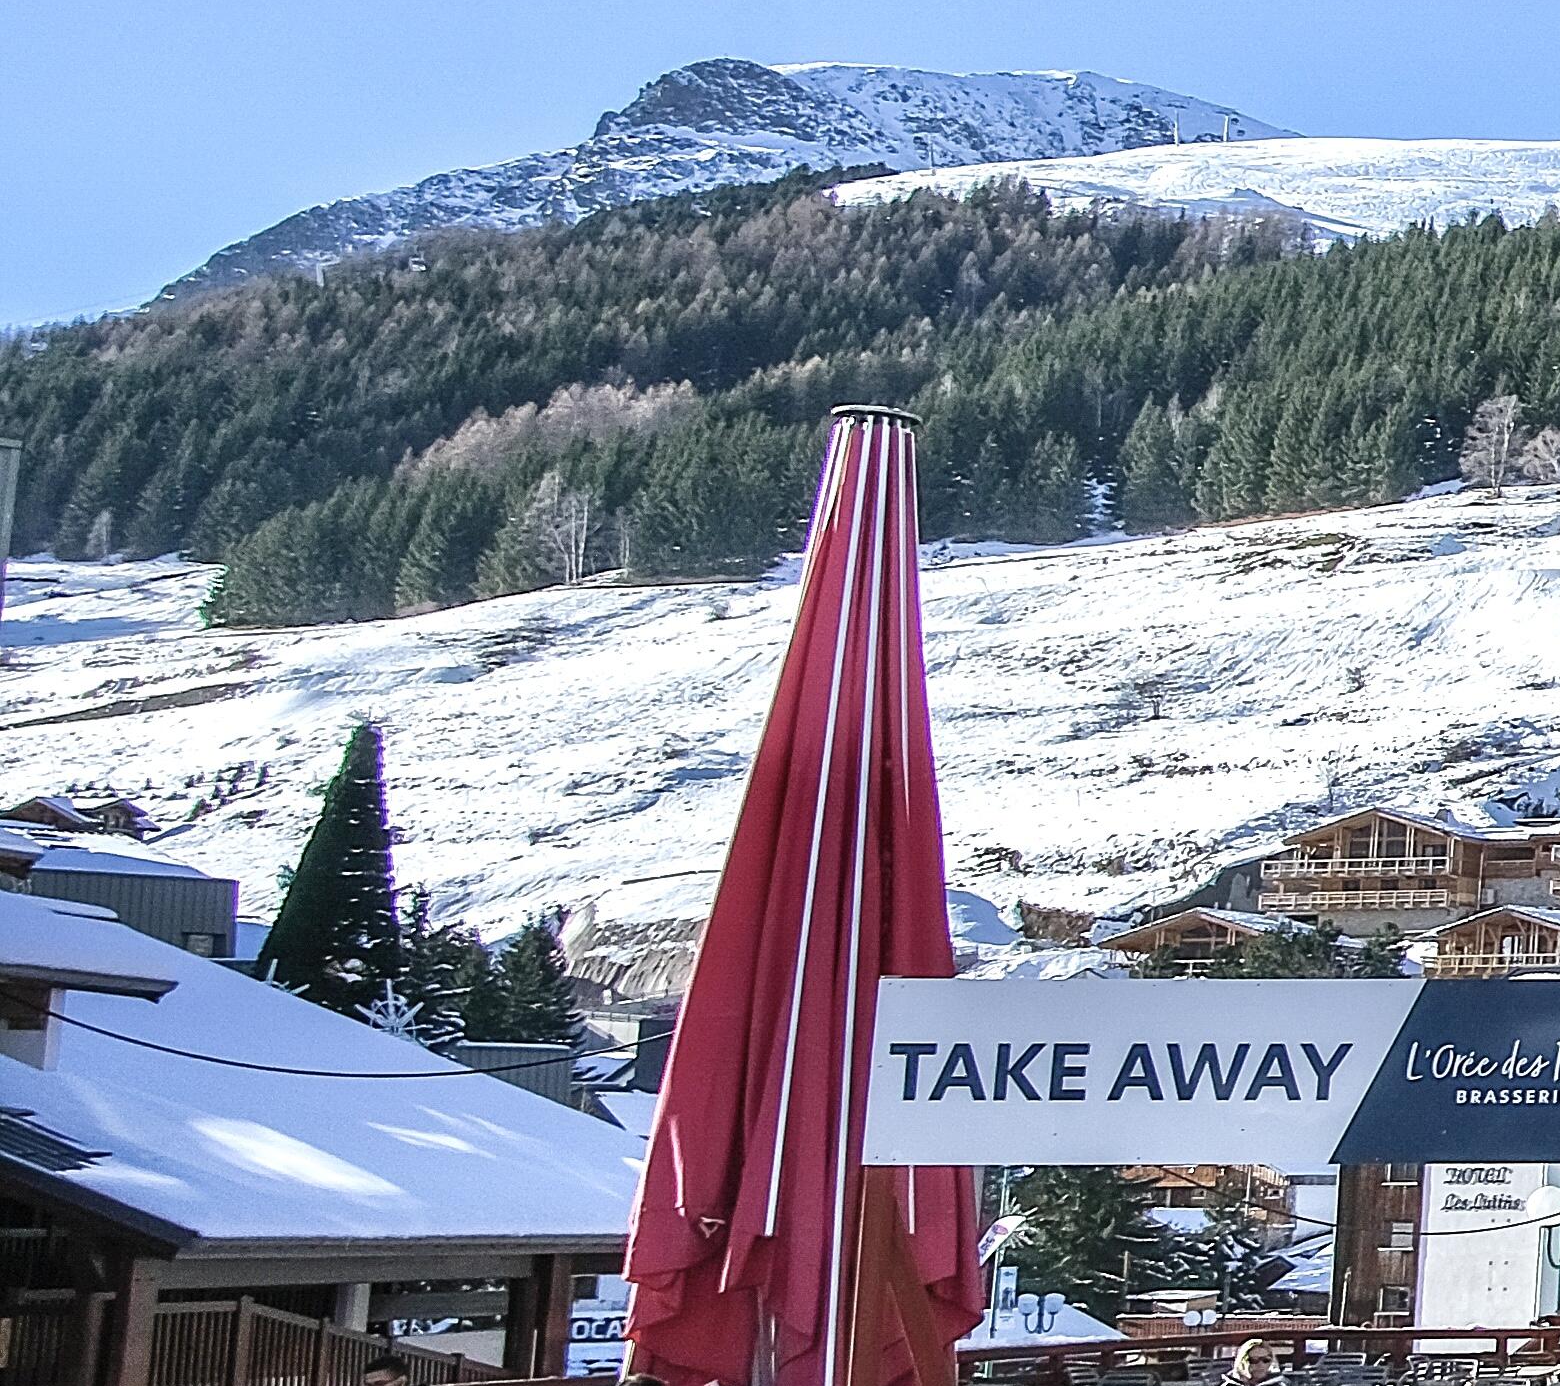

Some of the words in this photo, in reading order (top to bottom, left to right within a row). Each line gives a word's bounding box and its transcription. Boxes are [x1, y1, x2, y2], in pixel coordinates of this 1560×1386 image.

[890, 1042, 1090, 1101] TAKE
[1107, 1042, 1354, 1101] AWAY
[1406, 1041, 1498, 1081] L'Orée
[1501, 1039, 1550, 1080] des
